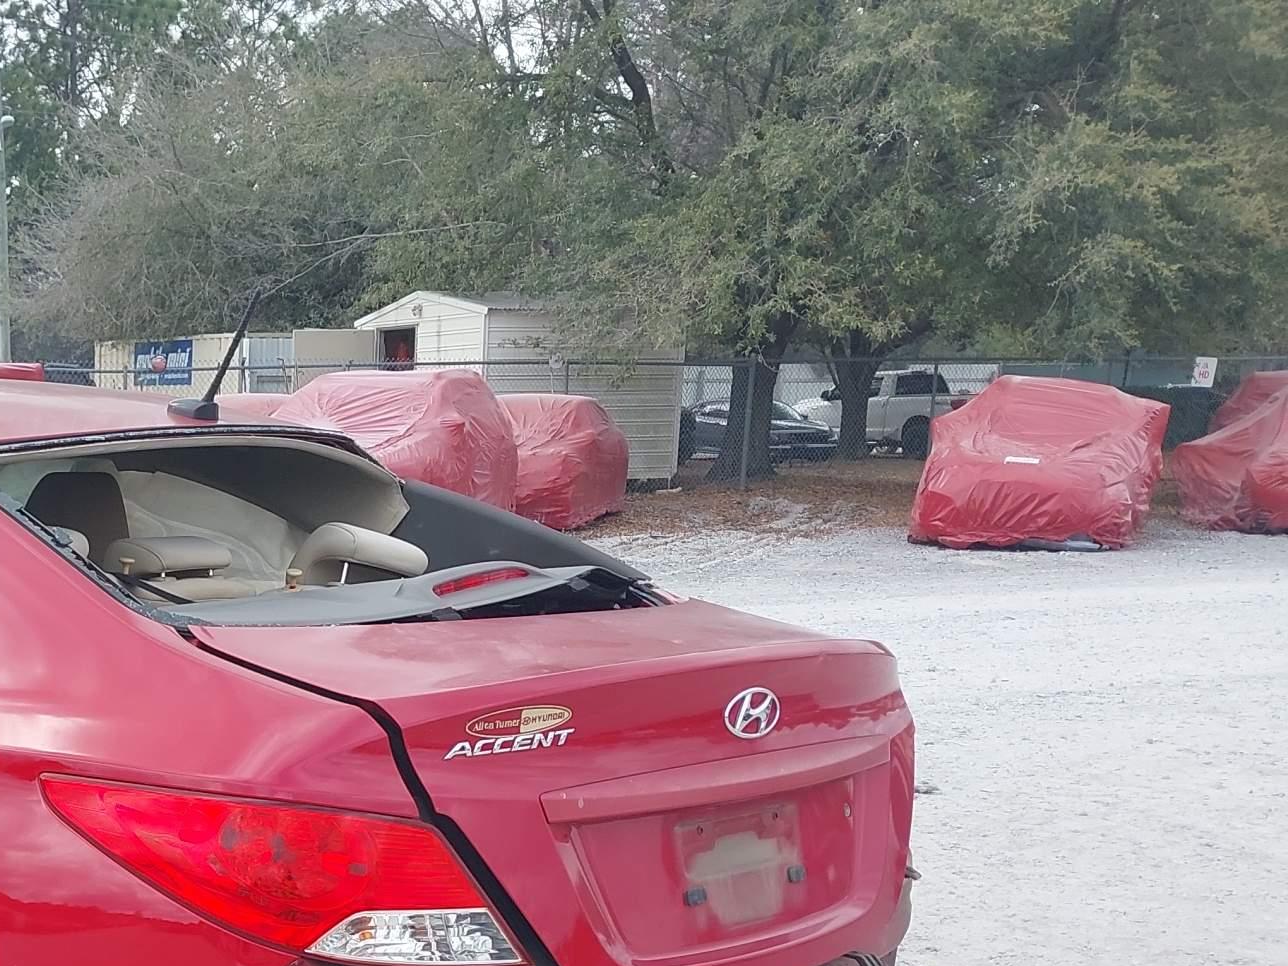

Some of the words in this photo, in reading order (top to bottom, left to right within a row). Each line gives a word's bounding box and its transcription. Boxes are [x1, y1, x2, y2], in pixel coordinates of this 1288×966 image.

[472, 720, 494, 731] Allen
[531, 711, 566, 724] HYUNDAI
[443, 728, 575, 760] ACCENT
